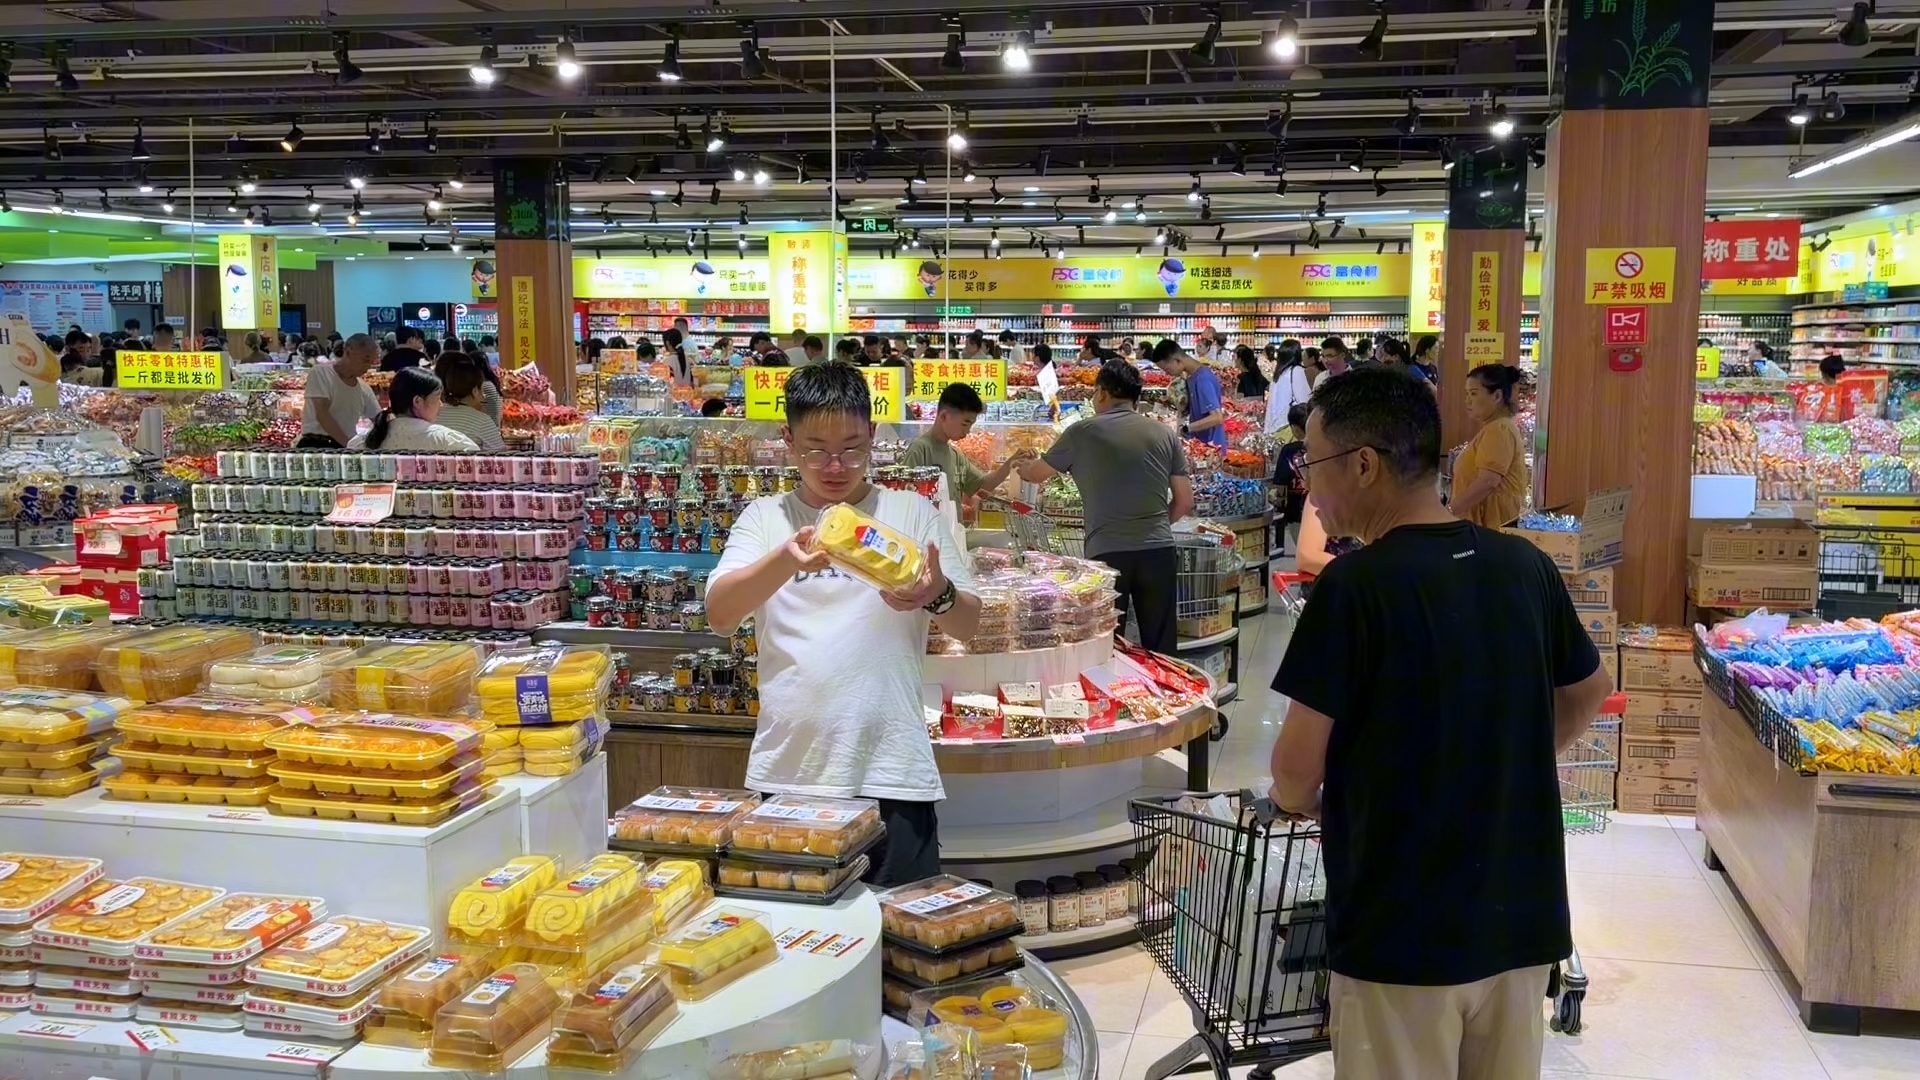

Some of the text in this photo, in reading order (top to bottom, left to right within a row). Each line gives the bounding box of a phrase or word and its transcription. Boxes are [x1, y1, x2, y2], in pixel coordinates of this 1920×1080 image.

[1704, 236, 1790, 263] 称重处
[719, 269, 756, 280] 只买一个
[1191, 267, 1232, 277] 精选细选
[261, 256, 273, 316] 店中店
[792, 257, 807, 305] 称重处
[964, 281, 998, 292] 买得多
[1200, 279, 1253, 290] 只卖品质优
[1478, 256, 1492, 311] 勤俭节约
[110, 284, 142, 296] 洗手间
[1592, 281, 1666, 299] 严禁吸烟
[123, 353, 216, 368] 快乐零食特惠柜
[123, 371, 216, 385] 一斤都是批发价
